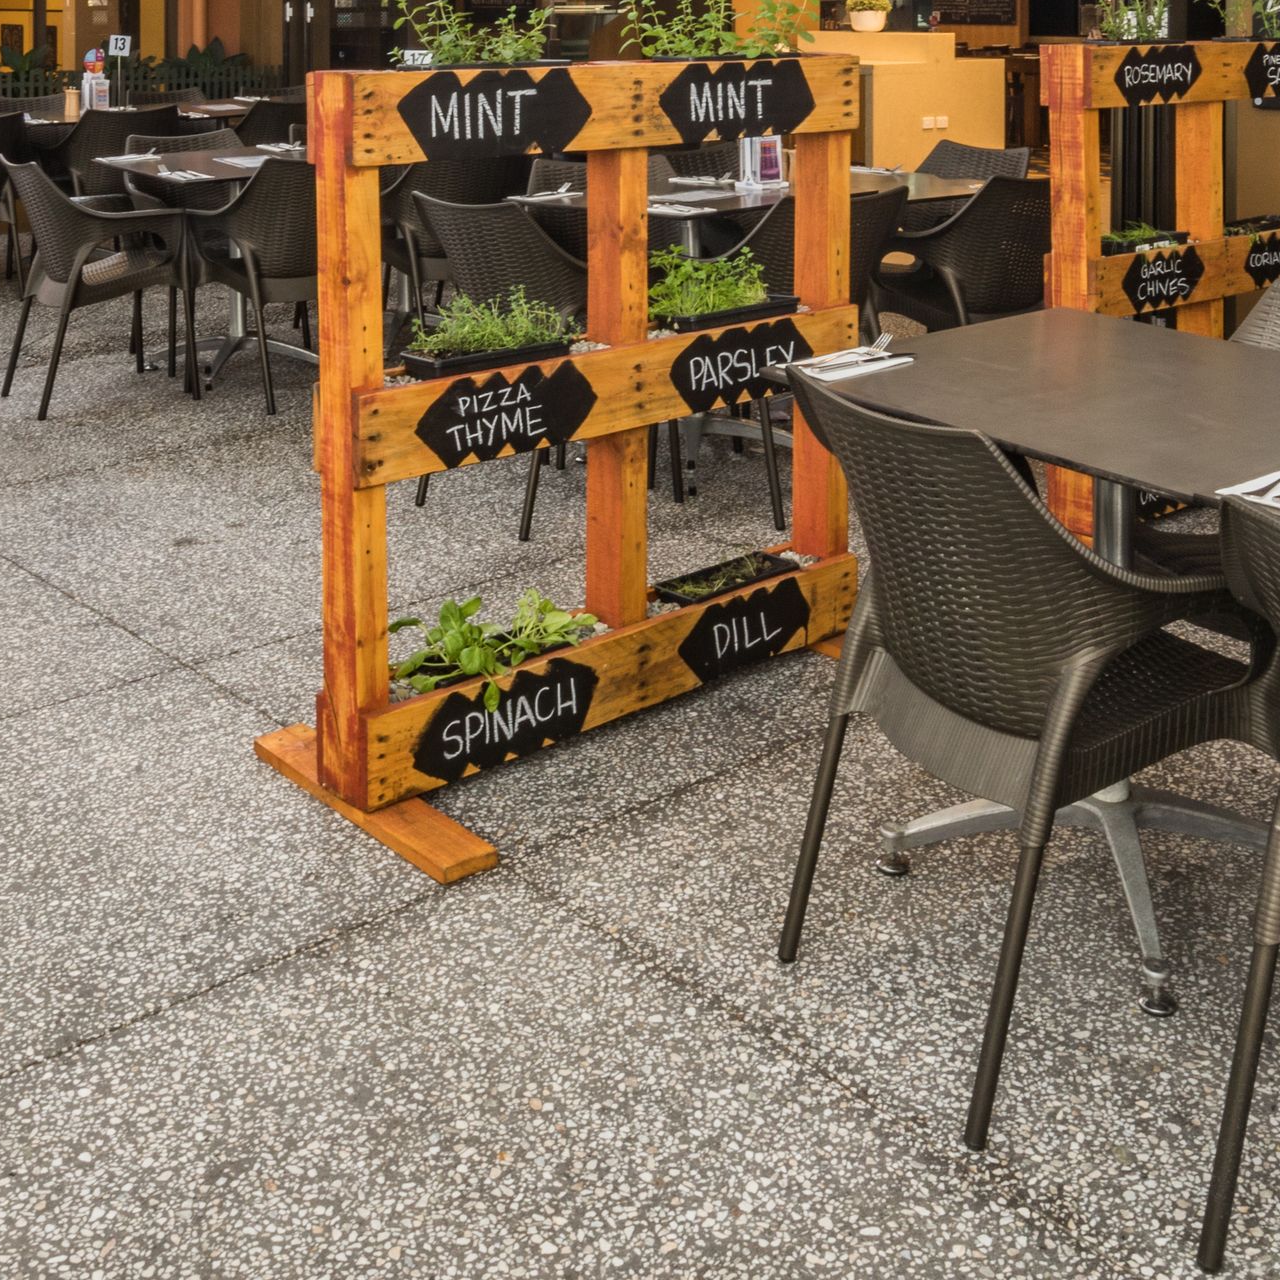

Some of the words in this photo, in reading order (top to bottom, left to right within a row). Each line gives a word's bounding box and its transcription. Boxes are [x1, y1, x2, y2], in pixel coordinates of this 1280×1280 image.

[114, 37, 126, 51] 13
[1125, 63, 1192, 87] ROSEMARY
[430, 88, 537, 140] MINT
[689, 79, 772, 122] MINT
[1138, 278, 1190, 300] CHIVES
[1141, 260, 1182, 278] GARLIC
[690, 341, 794, 391] PARSLEY
[458, 383, 531, 416] PIZZA
[446, 405, 548, 452] THYME
[712, 611, 782, 659] DILL
[443, 678, 577, 760] SPINACH
